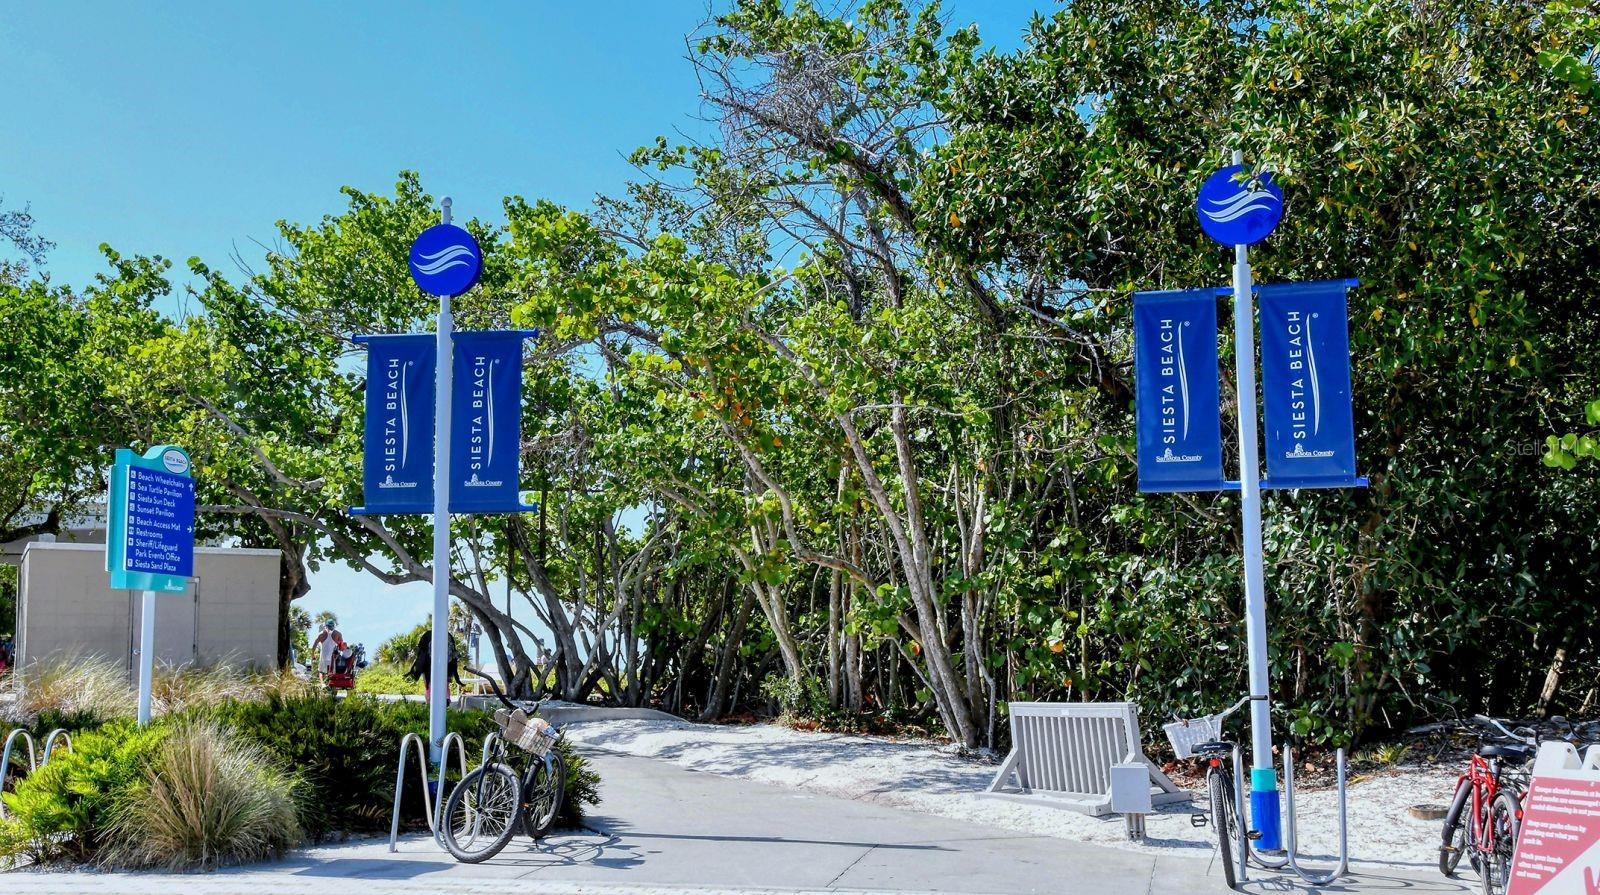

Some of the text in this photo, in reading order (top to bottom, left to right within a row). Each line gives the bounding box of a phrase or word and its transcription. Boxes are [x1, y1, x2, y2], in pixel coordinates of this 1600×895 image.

[1161, 320, 1175, 444] SIESTA BEACH
[1288, 311, 1306, 439] SIESTA BEACH
[386, 358, 399, 472] SIESTA BEACH
[471, 356, 486, 470] SIESTA BEACH
[138, 472, 184, 488] Beach Wheelchairs
[138, 483, 182, 498] Sea Turtle Pavilion
[138, 493, 175, 507] Siesta Sun Deck
[137, 504, 174, 517] Sunset Pavilion
[137, 517, 152, 526] Beach
[154, 520, 170, 529] Access
[136, 528, 163, 538] Restrooms
[136, 539, 178, 552] Sheriff/Lifeguard
[136, 549, 180, 562] Park Events Office
[135, 560, 176, 571] Siesta Sand Plaza
